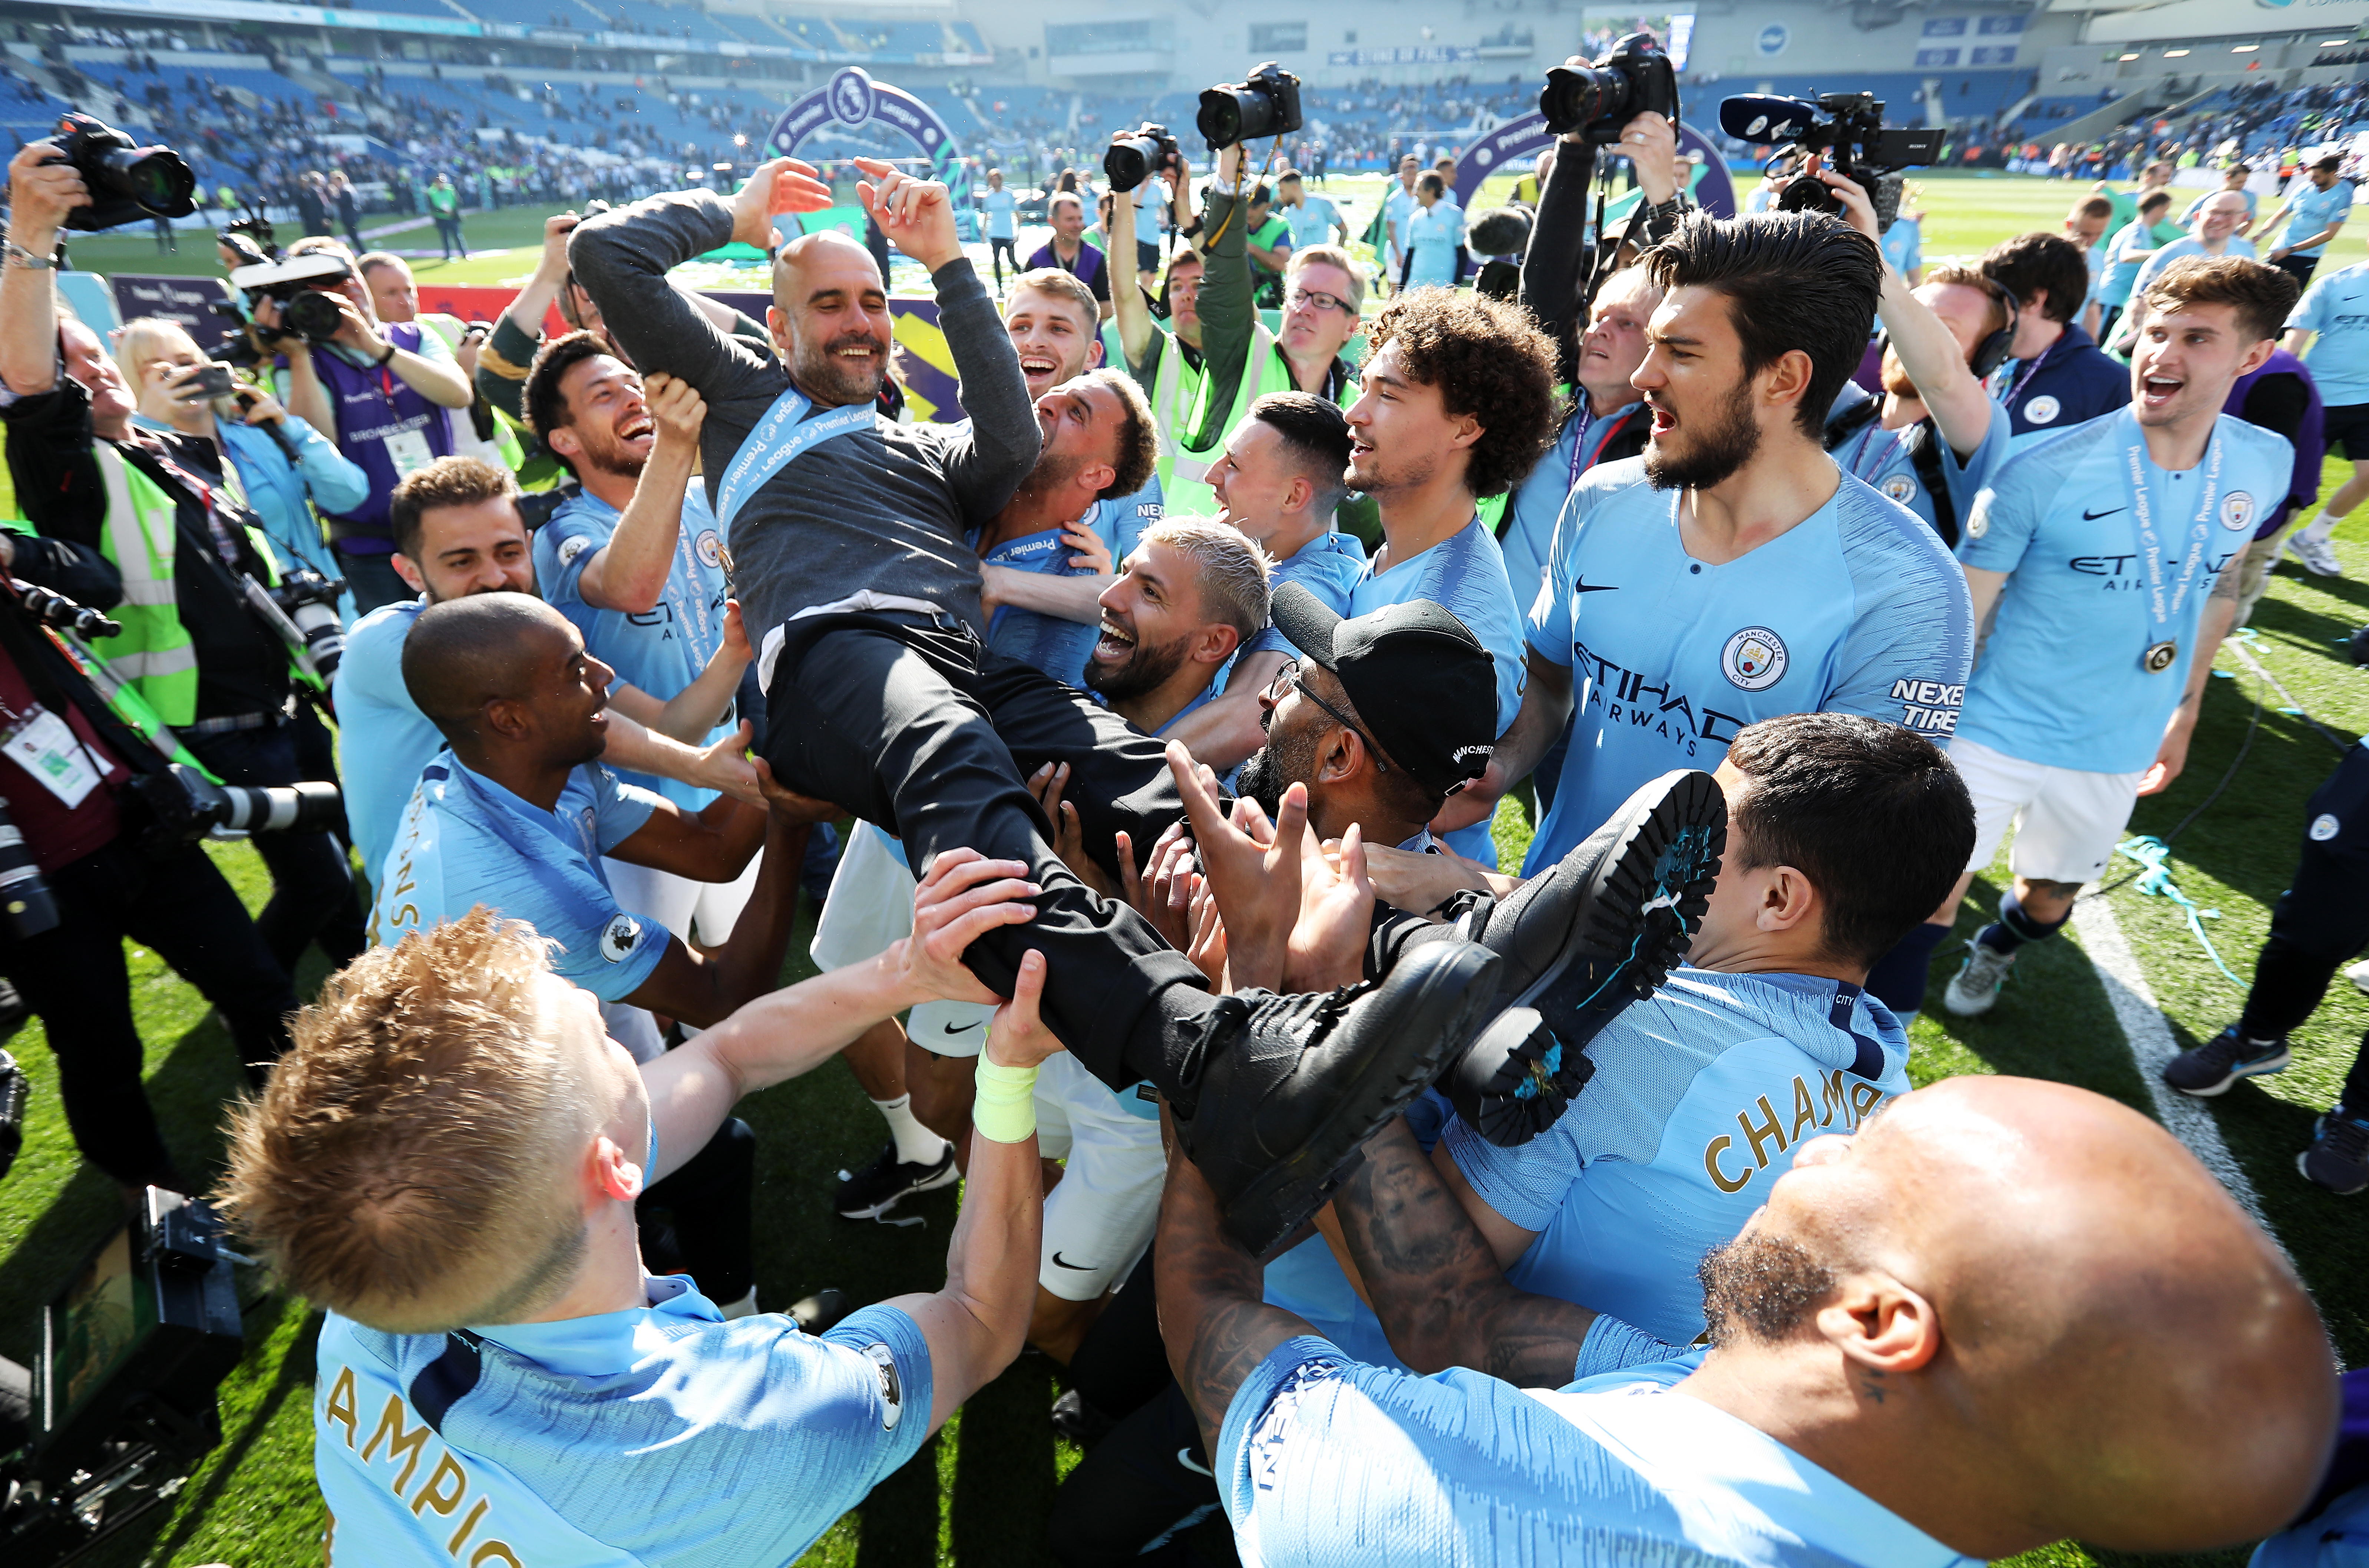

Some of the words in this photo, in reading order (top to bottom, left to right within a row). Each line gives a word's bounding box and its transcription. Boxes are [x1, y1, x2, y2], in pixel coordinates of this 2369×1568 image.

[814, 416, 850, 432] Premier
[730, 440, 767, 484] Premier
[761, 435, 803, 472] League
[2127, 445, 2146, 485] Premier
[718, 485, 736, 535] League
[2134, 486, 2151, 529] League
[2195, 482, 2217, 522] Premier
[681, 539, 698, 579] Premier
[1010, 538, 1056, 555] Premier
[2145, 546, 2164, 585] Premier
[2177, 542, 2204, 582] League
[675, 599, 694, 639] Premier
[2151, 585, 2167, 624] League
[1738, 631, 1783, 661] MANCHESTER
[1732, 674, 1751, 686] CITY
[1590, 689, 1697, 757] AIRWAYS
[1903, 705, 1960, 732] TIRE
[1836, 994, 1854, 1006] CITY
